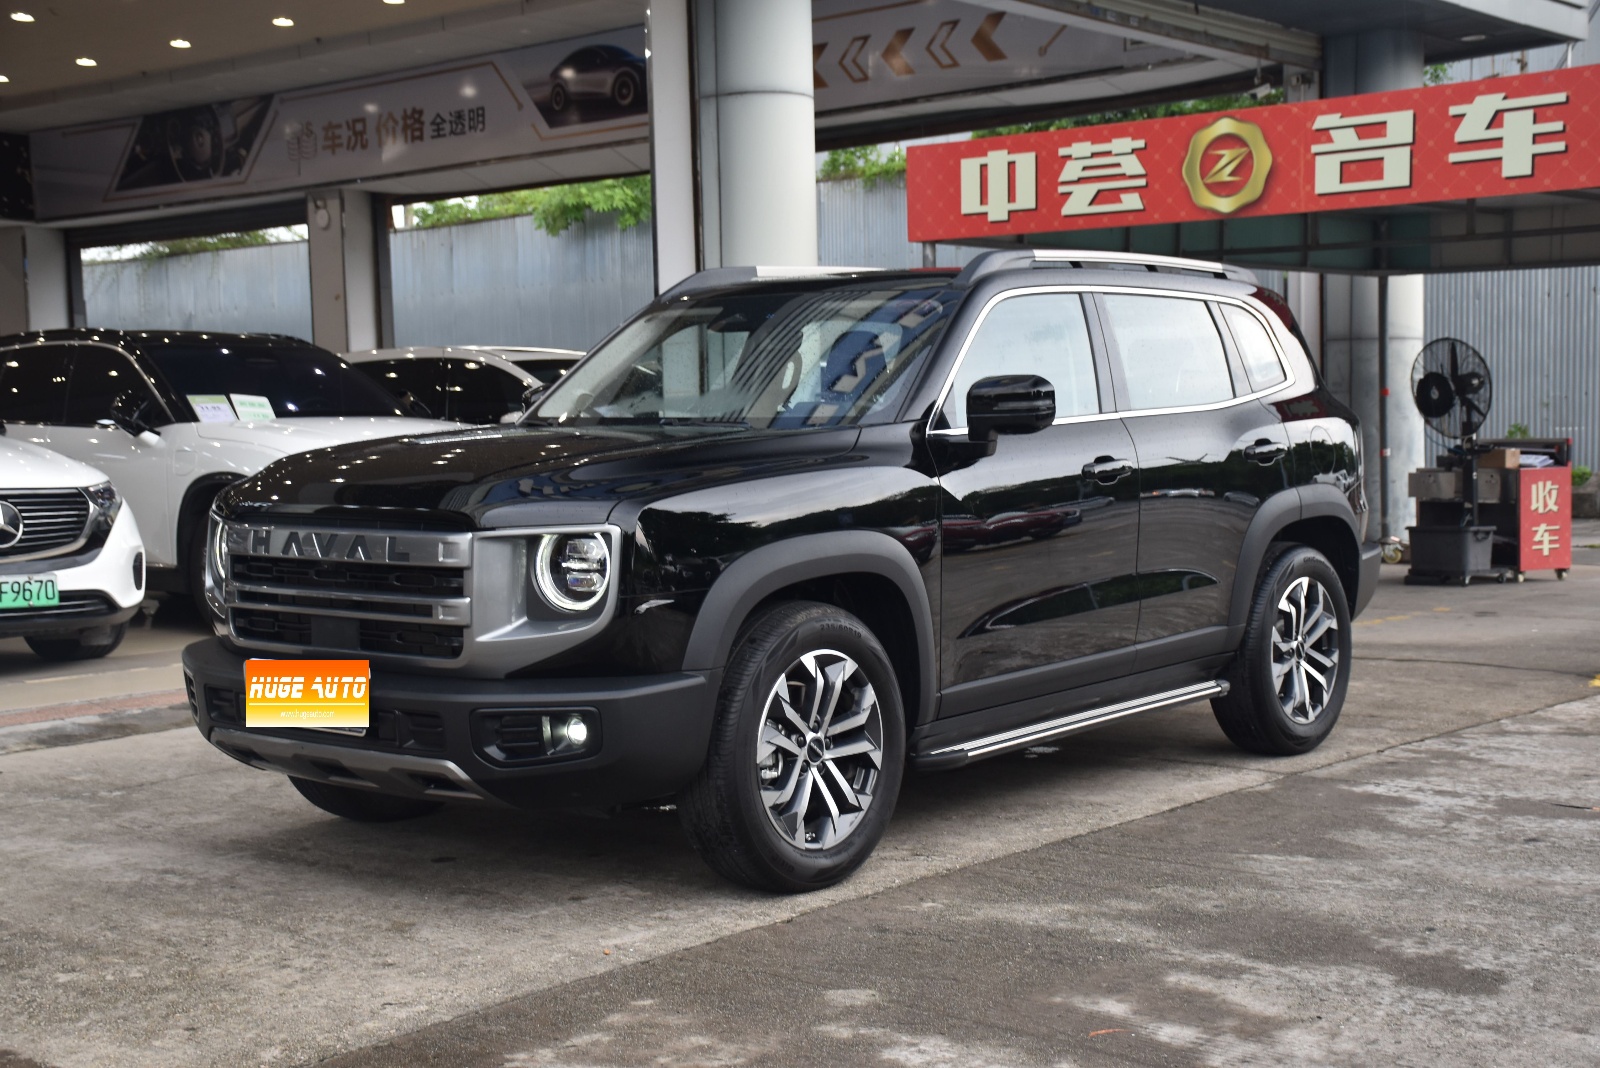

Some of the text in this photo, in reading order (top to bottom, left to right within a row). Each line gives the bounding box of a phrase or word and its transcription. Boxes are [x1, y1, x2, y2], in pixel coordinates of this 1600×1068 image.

[321, 106, 486, 155] 车况 价格 全透明
[960, 137, 1147, 223] 中荟
[1310, 91, 1568, 195] 名车
[1530, 480, 1561, 557] 收车
[250, 529, 410, 563] HAVAL
[0, 580, 55, 602] F9670
